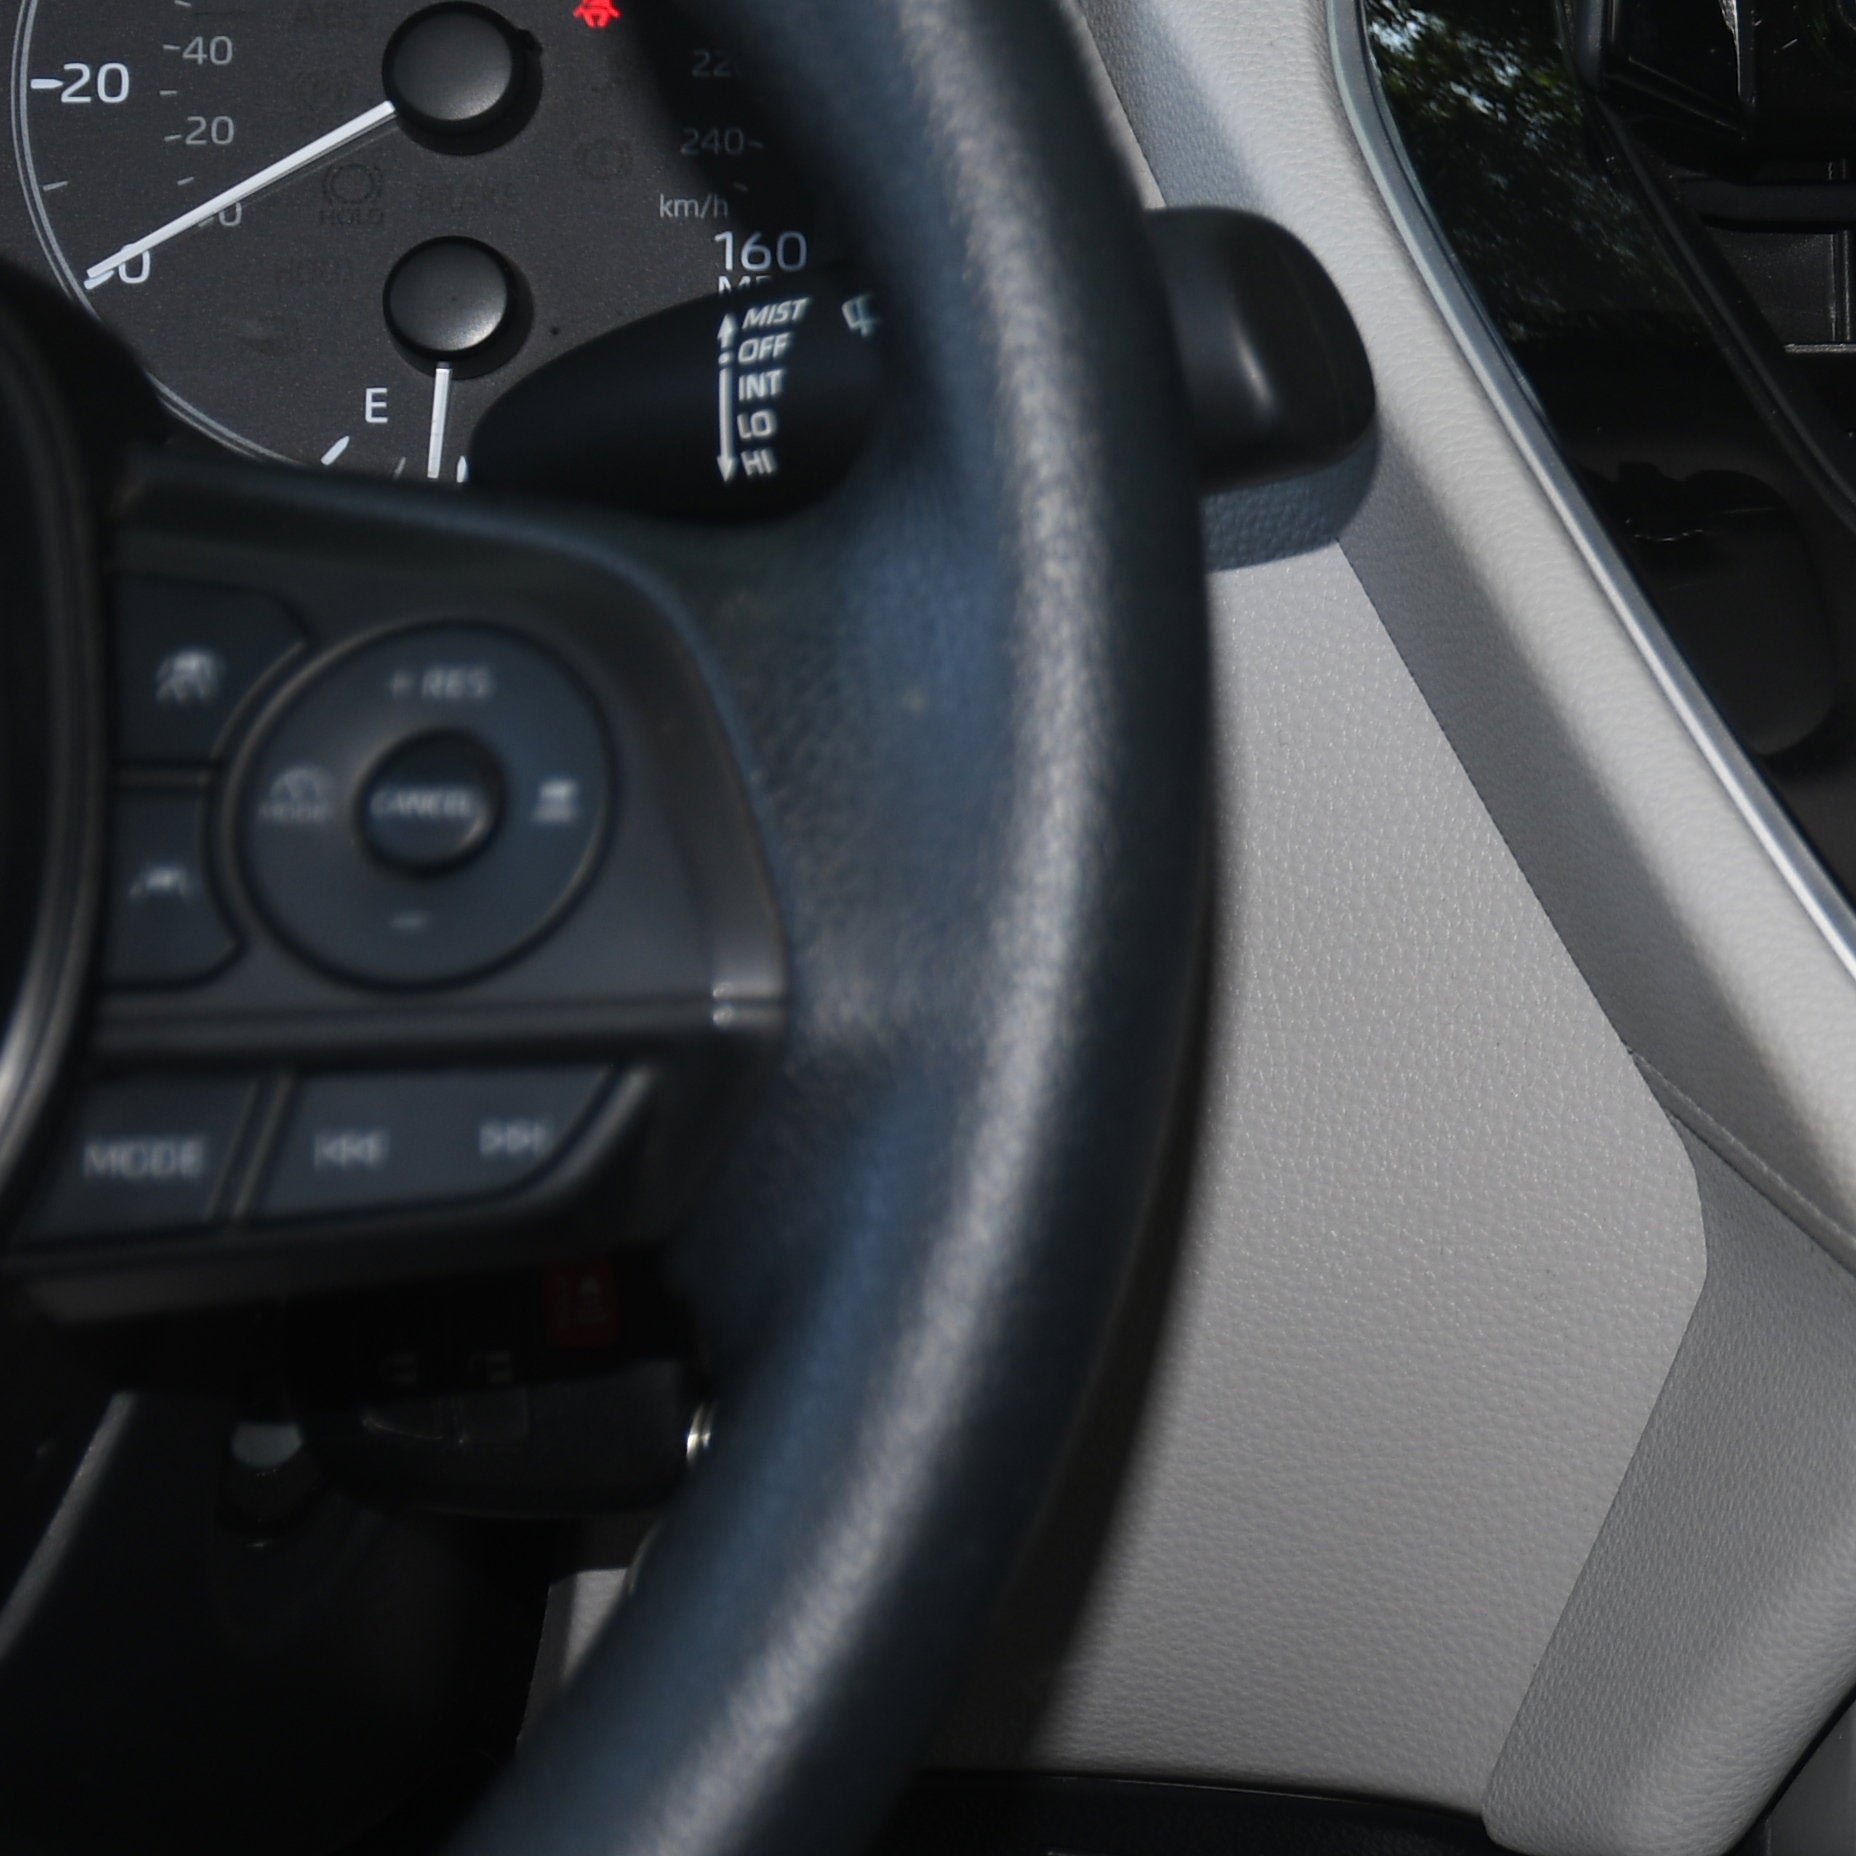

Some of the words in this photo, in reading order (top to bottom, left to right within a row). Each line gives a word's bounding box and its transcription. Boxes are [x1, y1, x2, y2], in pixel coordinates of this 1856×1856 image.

[181, 35, 234, 65] 40
[59, 63, 130, 104] 20
[181, 117, 235, 146] 20
[680, 126, 745, 156] 240
[659, 194, 730, 219] km/h
[714, 230, 808, 273] 160
[742, 297, 812, 331] MIST
[737, 332, 793, 365] OFF
[738, 369, 785, 401] INT
[365, 387, 387, 424] E
[737, 410, 778, 440] LO
[740, 448, 778, 478] HI
[82, 1138, 206, 1181] MODE
